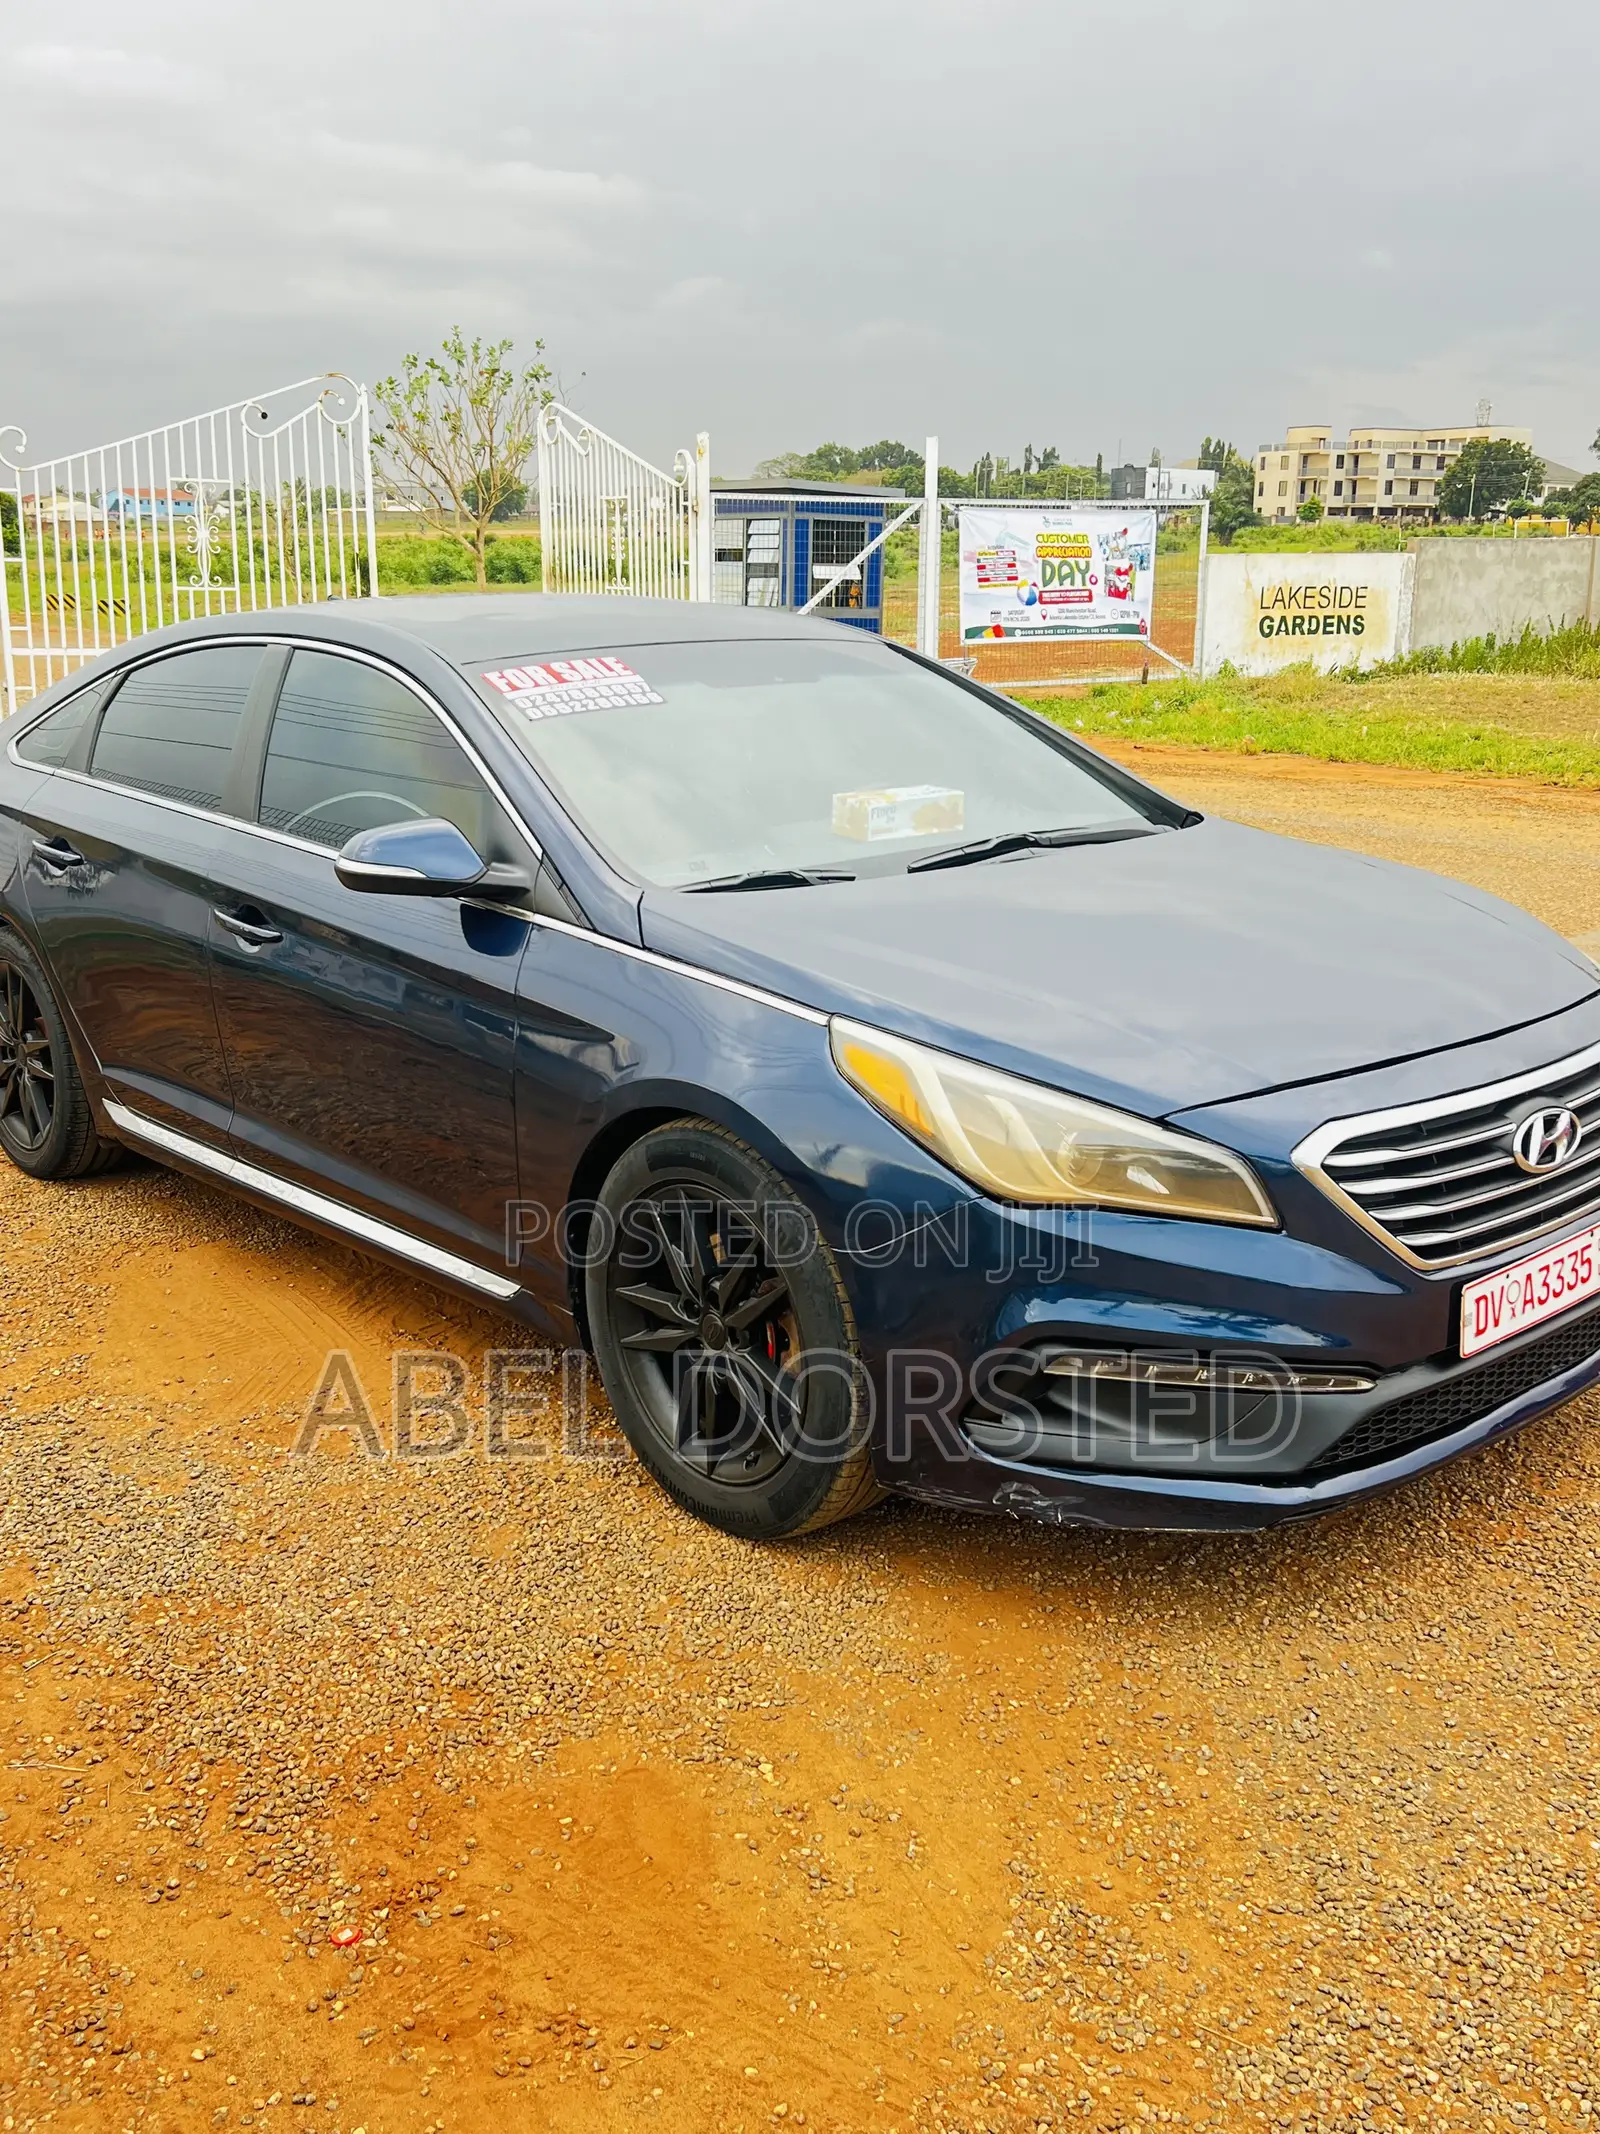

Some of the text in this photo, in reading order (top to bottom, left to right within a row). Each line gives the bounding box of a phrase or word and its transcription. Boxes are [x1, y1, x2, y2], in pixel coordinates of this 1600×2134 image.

[1036, 533, 1089, 544] CUSTOMER
[1036, 546, 1092, 558] APPRECIATION
[1042, 560, 1090, 587] DAY
[1260, 586, 1368, 609] LAKESIDE
[1259, 615, 1365, 638] GARDENS
[485, 665, 559, 692] FOR
[550, 657, 634, 682] SALE
[1475, 1285, 1504, 1338] DV
[1522, 1244, 1592, 1314] A3335
